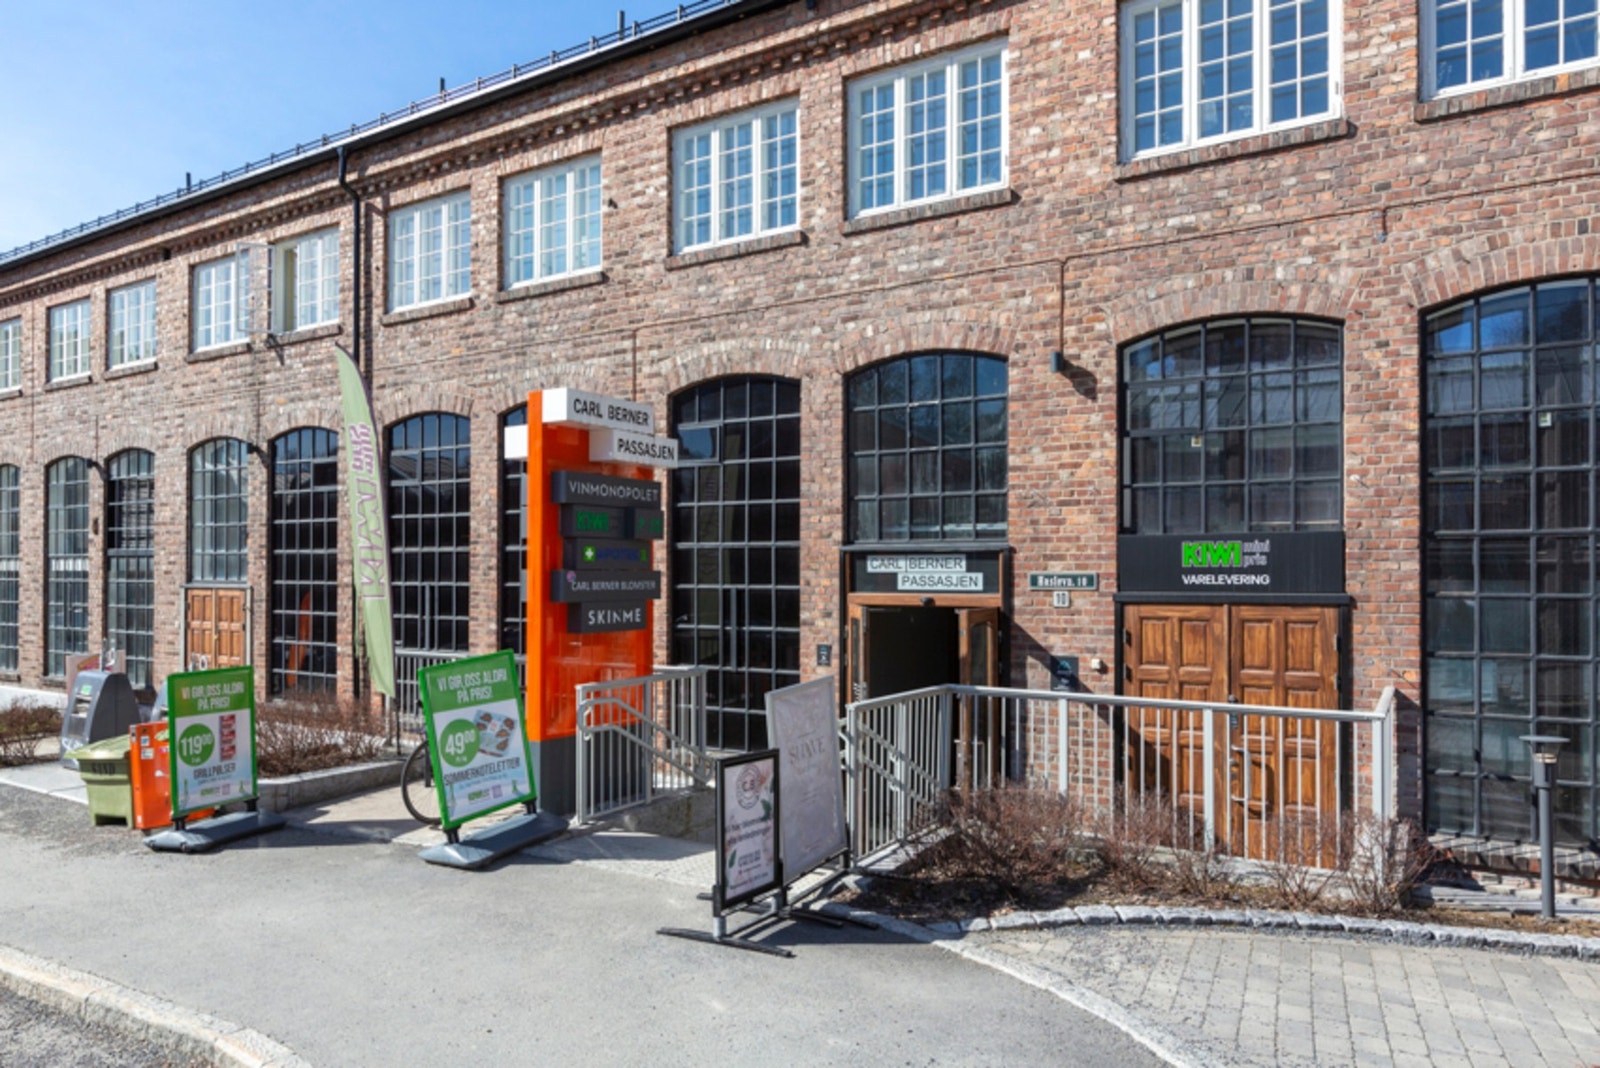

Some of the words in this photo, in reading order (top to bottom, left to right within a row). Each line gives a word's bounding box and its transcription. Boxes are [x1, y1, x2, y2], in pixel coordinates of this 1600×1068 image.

[573, 399, 603, 419] CARL
[607, 404, 649, 426] BERNER
[617, 437, 675, 460] PASSASJEN
[568, 480, 659, 501] VINMONOPOLET
[1181, 540, 1242, 568] KIWI
[870, 557, 903, 570] CARL
[908, 557, 963, 569] BERNER
[571, 581, 590, 591] CARL
[592, 580, 620, 591] BERNER
[901, 575, 978, 588] PASSASJEN
[1181, 574, 1270, 585] VARELEVERING
